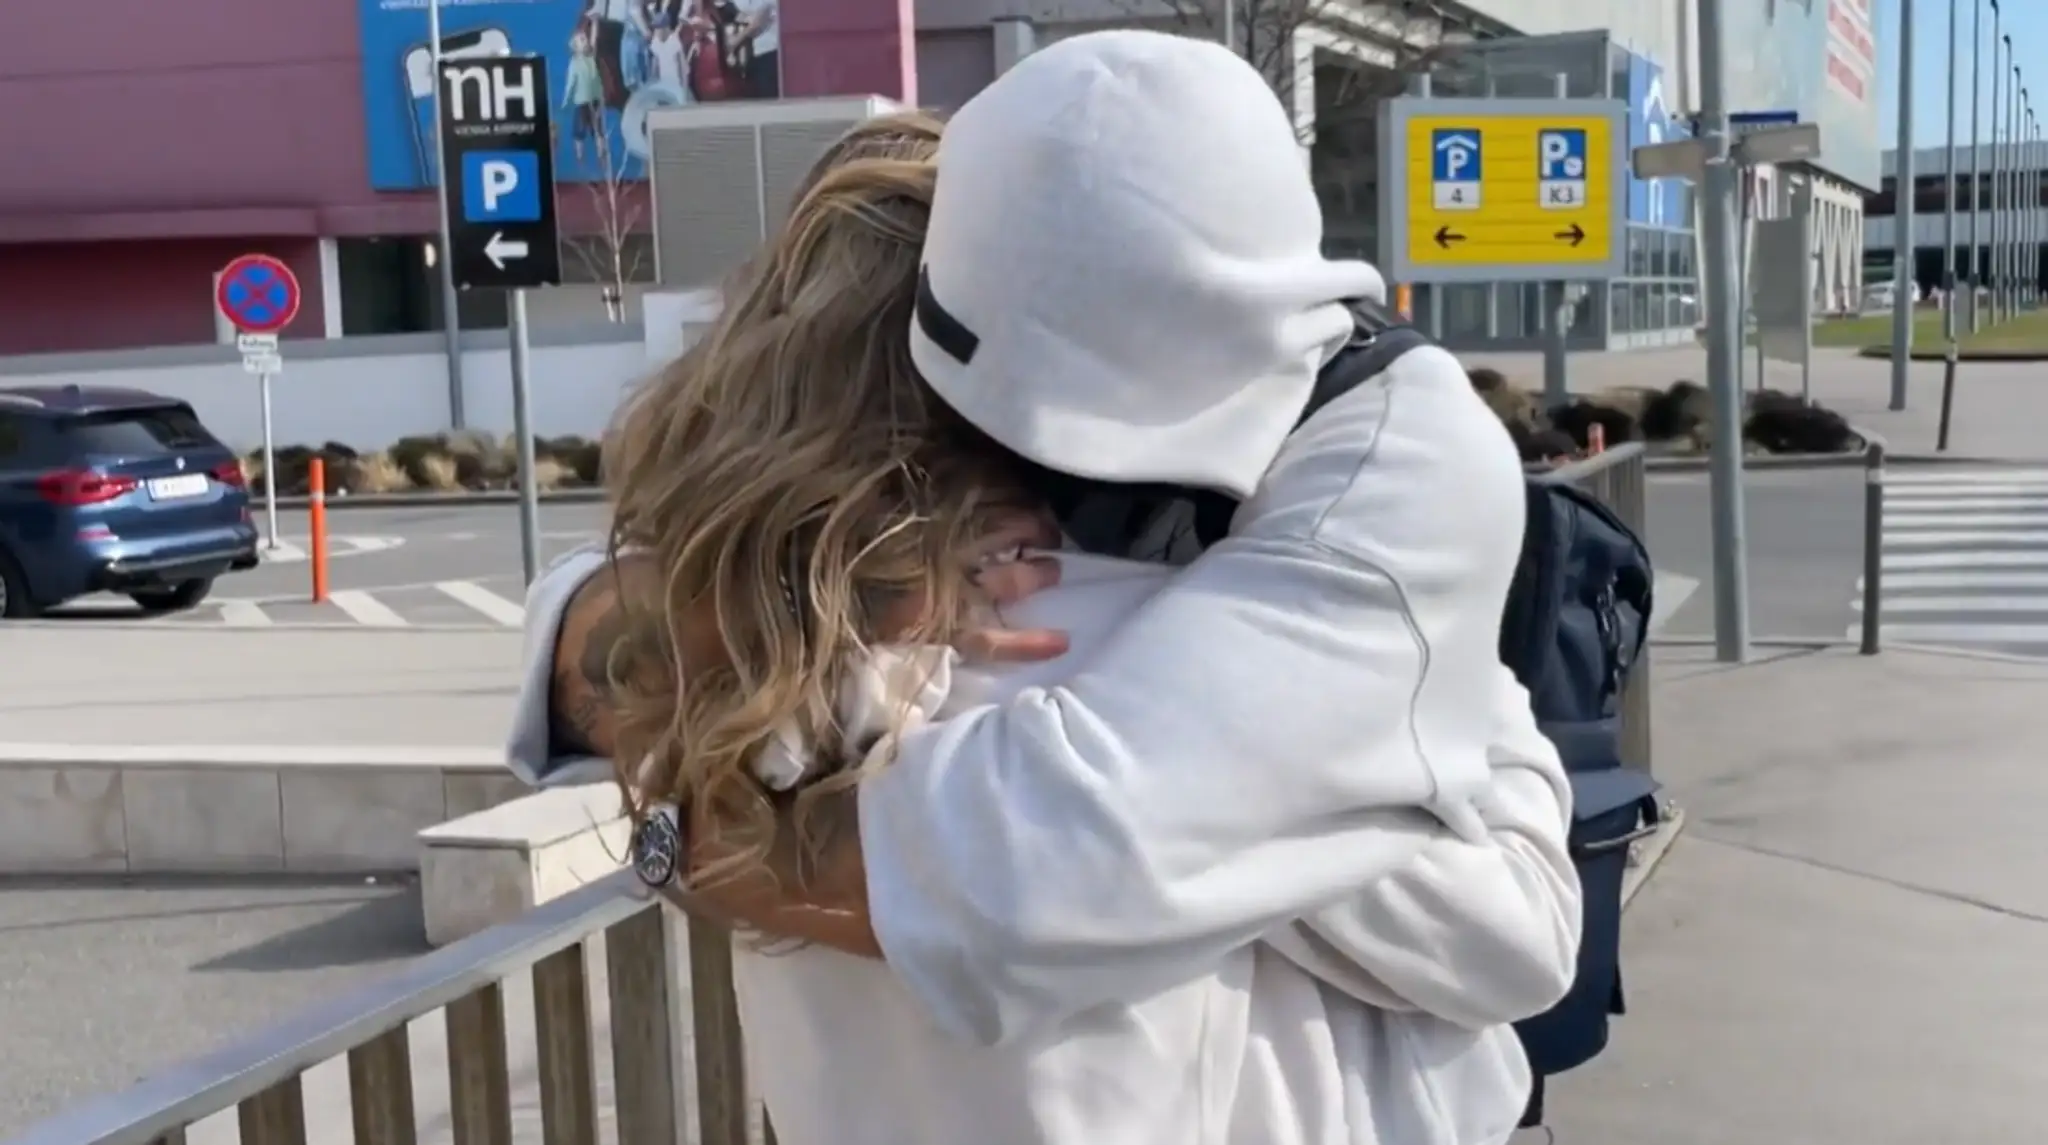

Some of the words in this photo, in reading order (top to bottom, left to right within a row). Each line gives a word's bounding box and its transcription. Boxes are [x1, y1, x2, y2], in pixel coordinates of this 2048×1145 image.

[493, 122, 536, 135] AIRPORT
[1447, 147, 1469, 179] P
[1541, 133, 1569, 176] P
[481, 160, 519, 212] P
[1451, 187, 1463, 204] 4
[1550, 186, 1574, 204] K3
